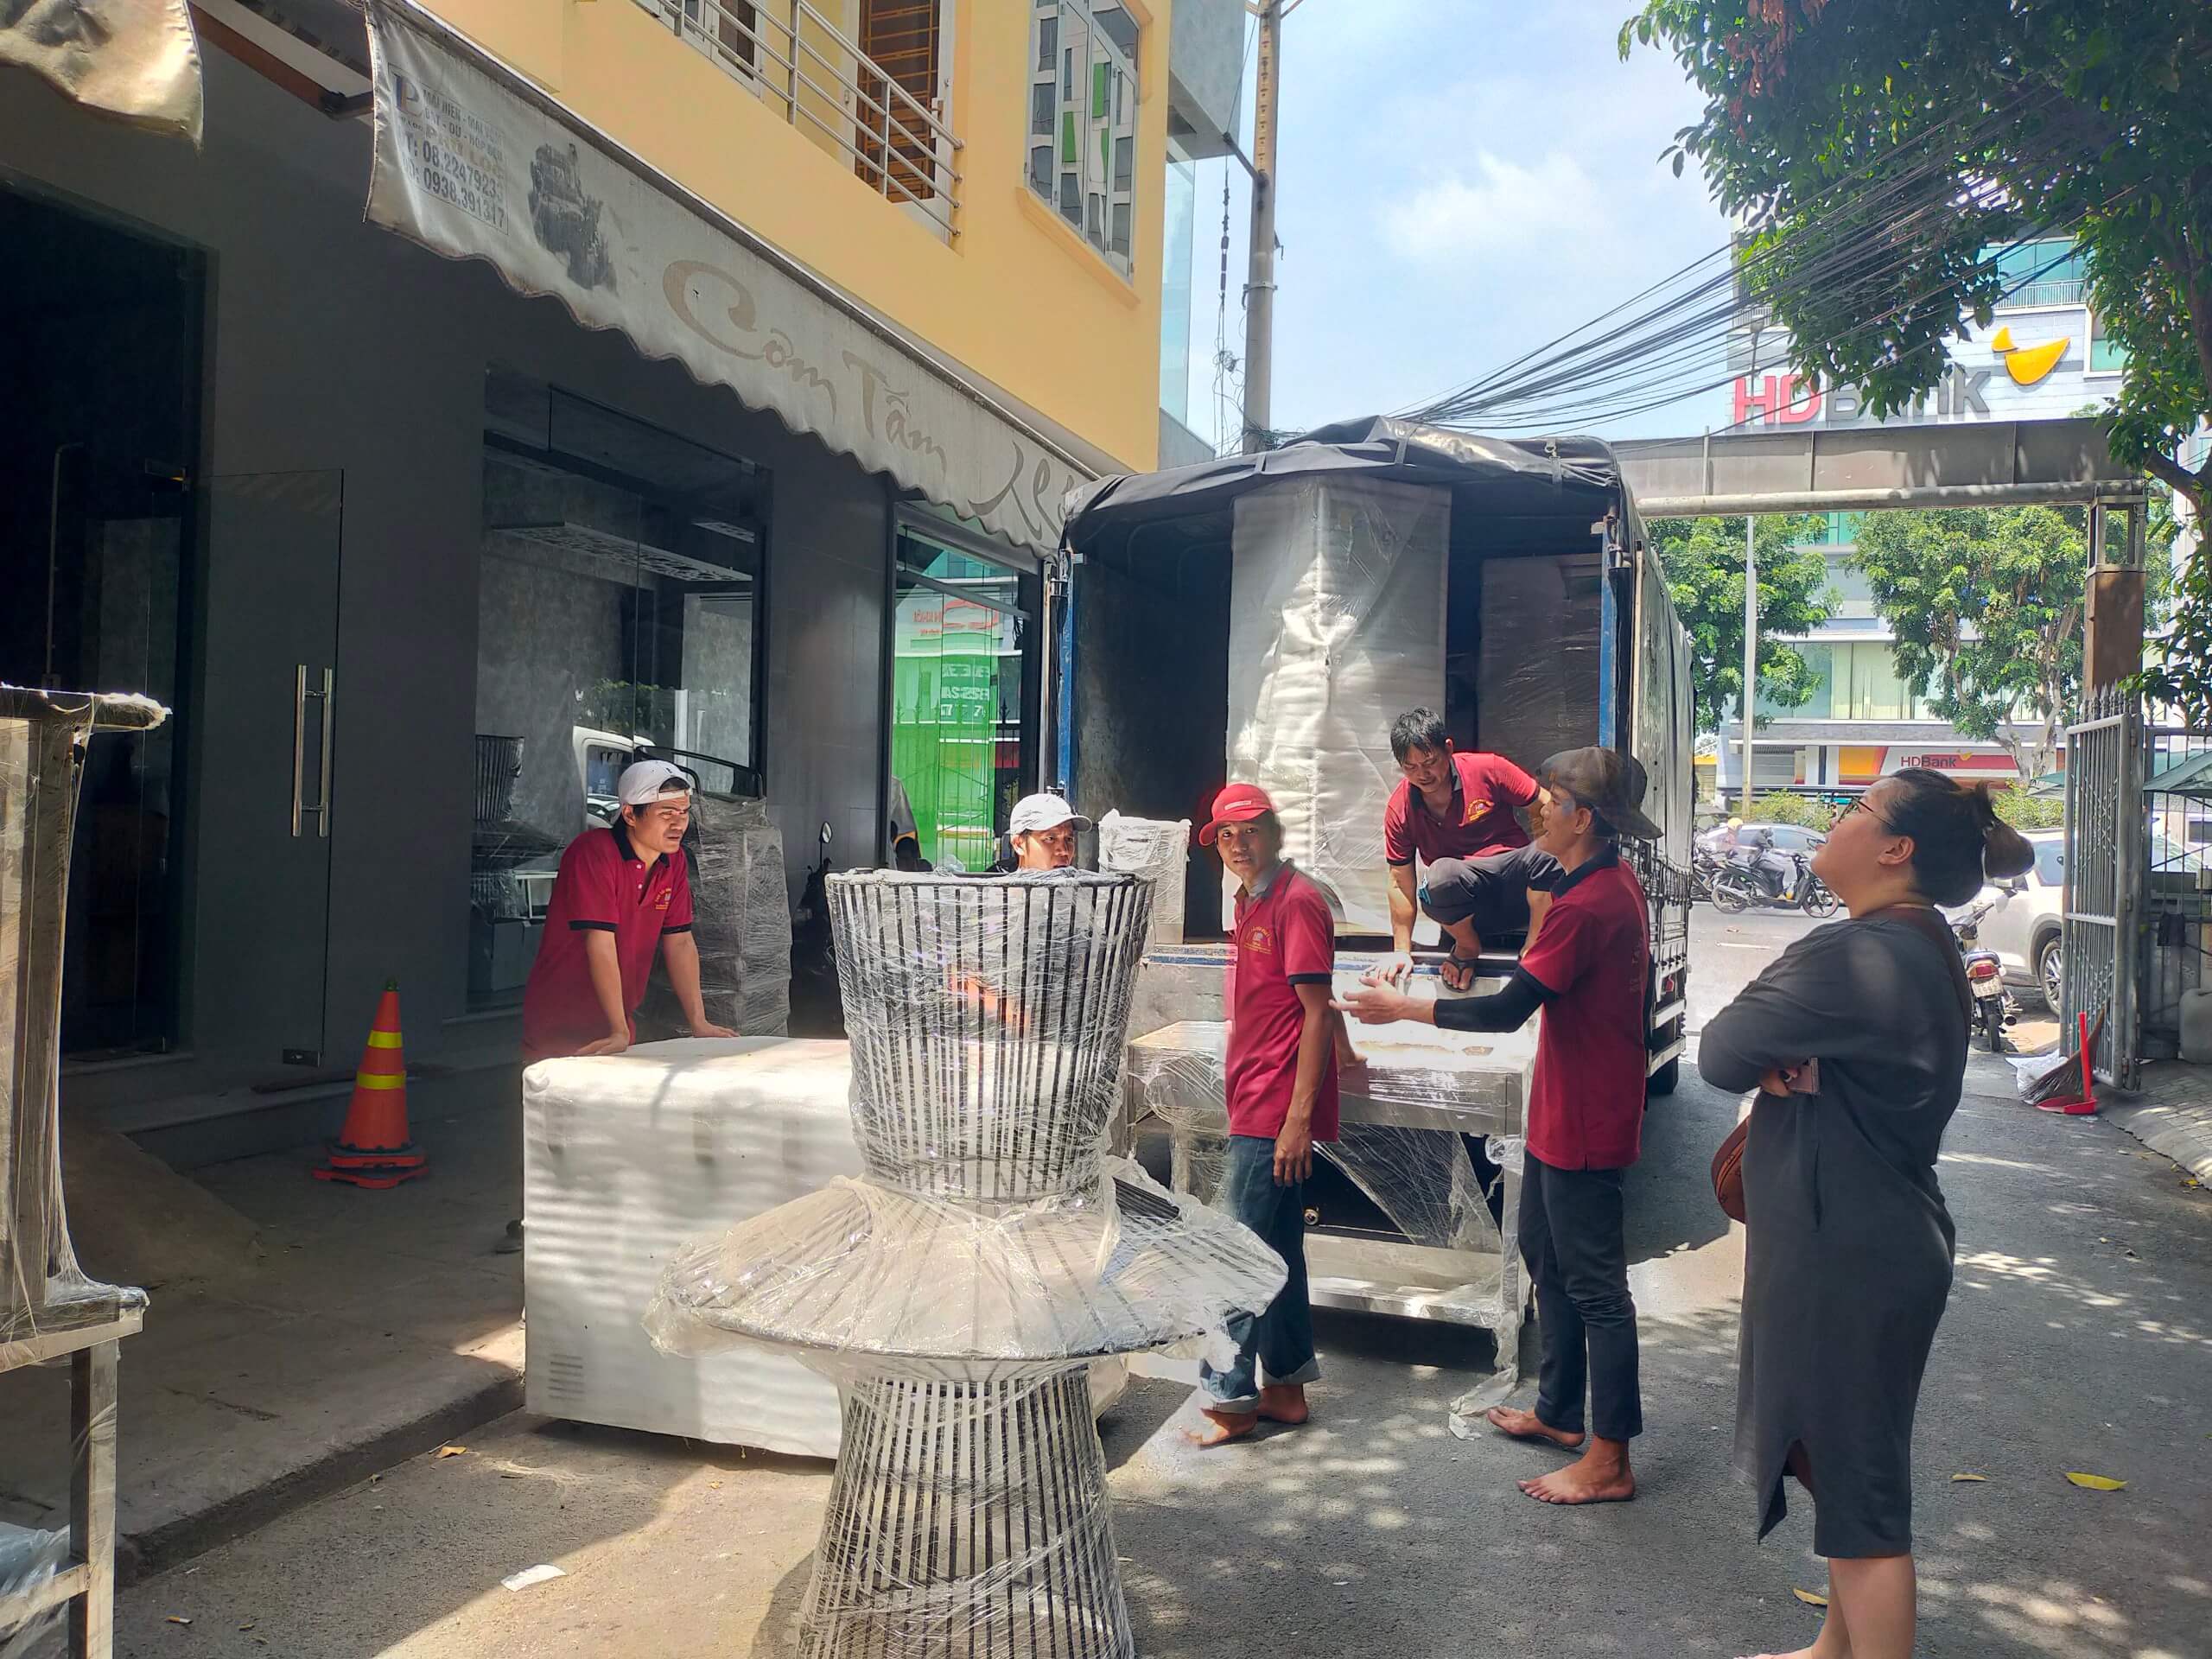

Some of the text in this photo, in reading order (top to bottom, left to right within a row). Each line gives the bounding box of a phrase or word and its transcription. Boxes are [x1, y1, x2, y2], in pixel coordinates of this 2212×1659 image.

[422, 166, 505, 229] 0938.391317
[1733, 361, 1991, 425] HDBnk
[1900, 756, 1957, 767] HDBank
